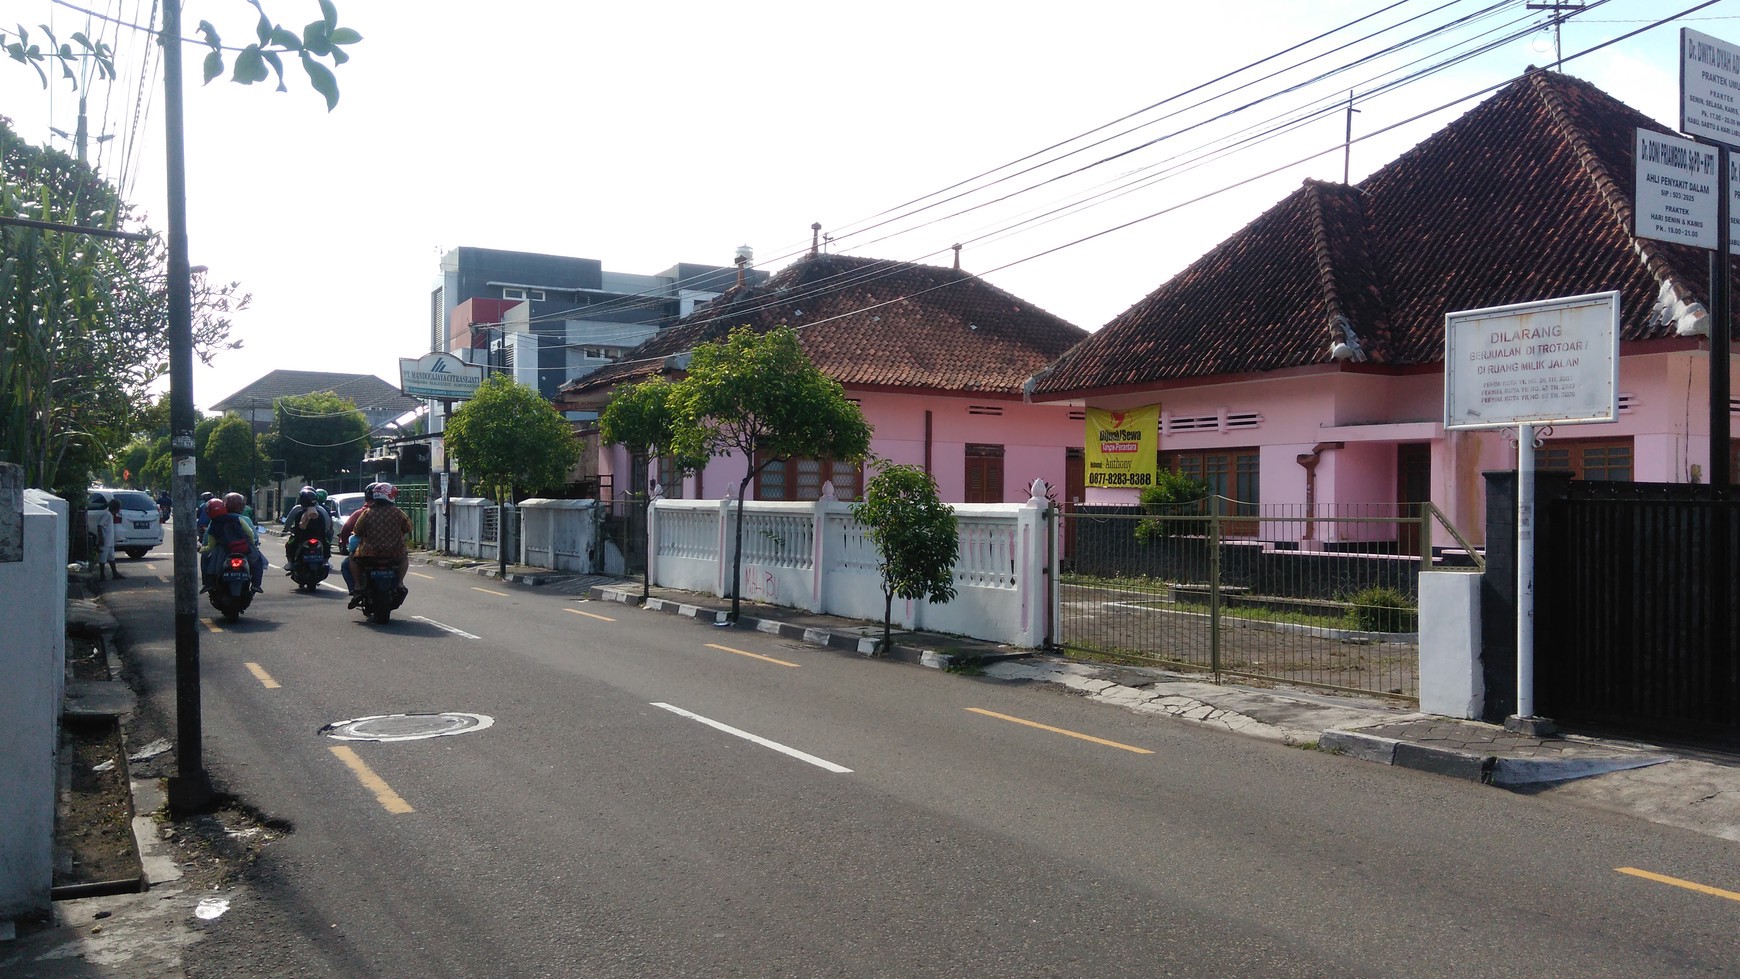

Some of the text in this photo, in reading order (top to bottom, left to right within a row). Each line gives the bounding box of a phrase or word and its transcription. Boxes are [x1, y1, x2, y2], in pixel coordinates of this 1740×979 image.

[1702, 71, 1727, 87] PRAKTEK
[1710, 90, 1733, 103] PRAKTEK
[1649, 140, 1660, 163] DONI
[1646, 173, 1710, 194] AHLI PENYAKIT DALAM
[1661, 189, 1669, 197] SIP
[1665, 205, 1689, 215] PRAKTEK
[1651, 213, 1664, 221] HARI
[1665, 216, 1681, 224] SENIN
[1687, 219, 1703, 228] KAMIS
[1490, 325, 1562, 344] DILARANG
[1470, 347, 1521, 361] BERJUALAN
[1526, 346, 1535, 355] DI
[1538, 341, 1582, 354] TROTOAR
[1477, 357, 1579, 375] DI RUANG MILIK JALAN
[1105, 457, 1132, 472] Anthony
[1089, 472, 1152, 485] 0877-8283-8388
